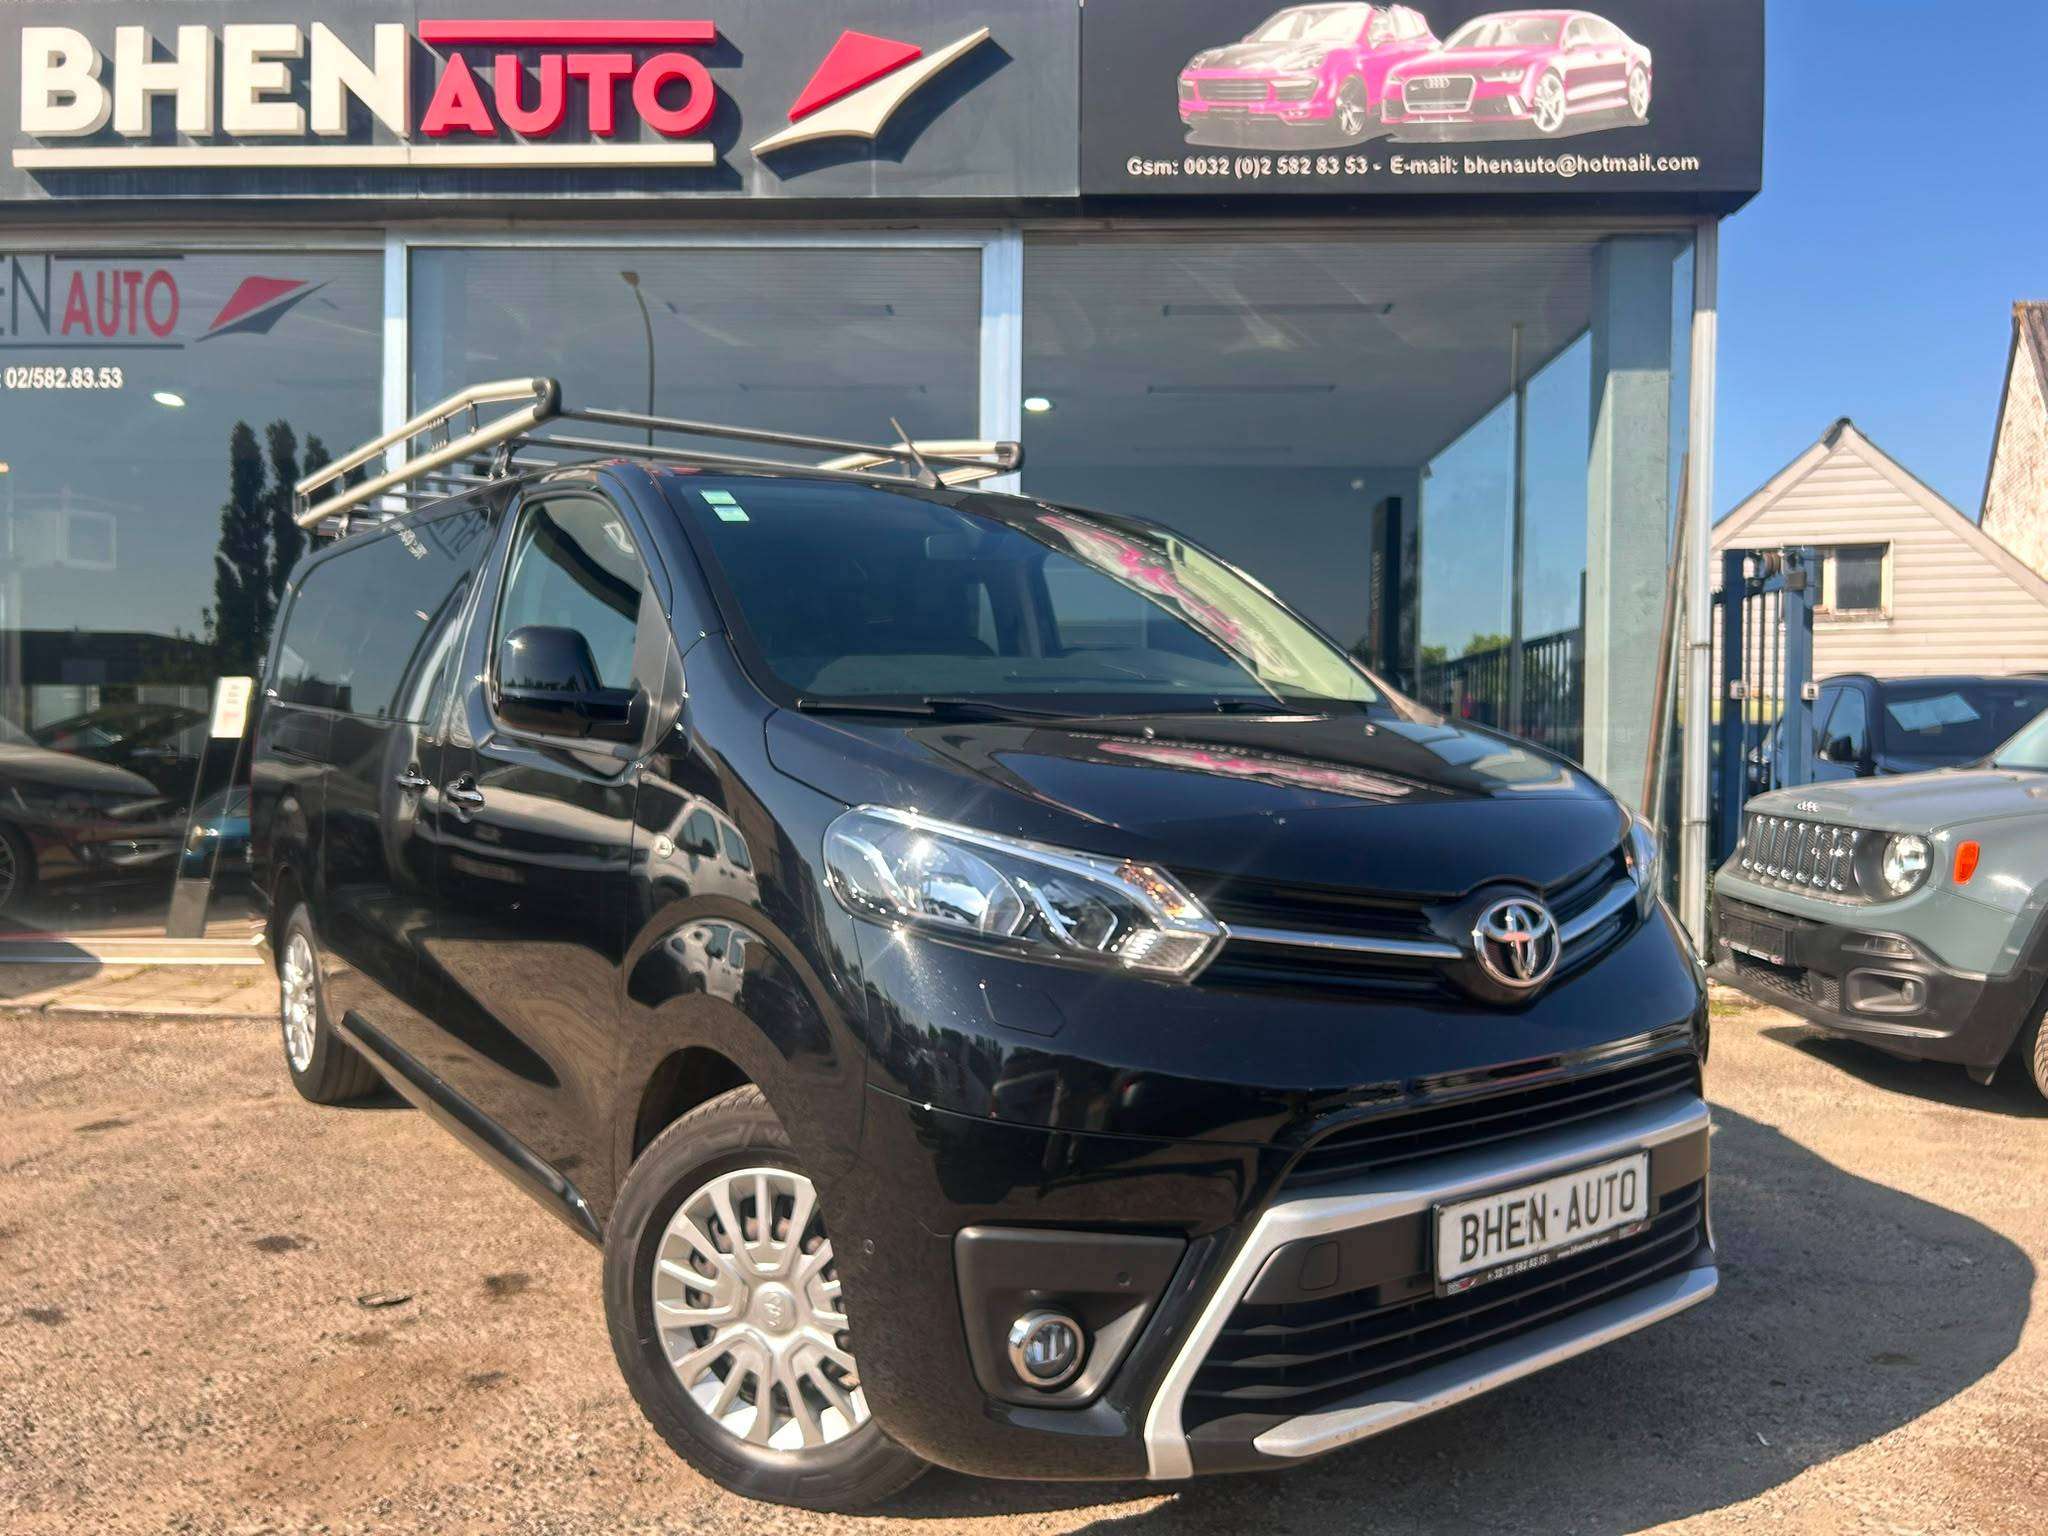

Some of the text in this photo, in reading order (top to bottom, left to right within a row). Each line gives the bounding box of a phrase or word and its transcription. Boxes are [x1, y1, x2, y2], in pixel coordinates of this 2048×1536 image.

[20, 22, 716, 138] BHEN AUTO
[1127, 156, 1178, 176] Gsm:
[1184, 156, 1230, 175] 0032
[1234, 156, 1272, 179] (0)2
[1277, 156, 1312, 175] 582
[1316, 156, 1340, 175] 83
[1344, 156, 1369, 175] 53
[1390, 155, 1458, 174] E-mail:
[1463, 154, 1700, 177] bhenauto@hotmail.com
[60, 269, 180, 337] AUTO
[5, 367, 123, 388] 02/582.83.53
[1460, 1193, 1546, 1263] BHEN
[1566, 1169, 1636, 1232] AUTO
